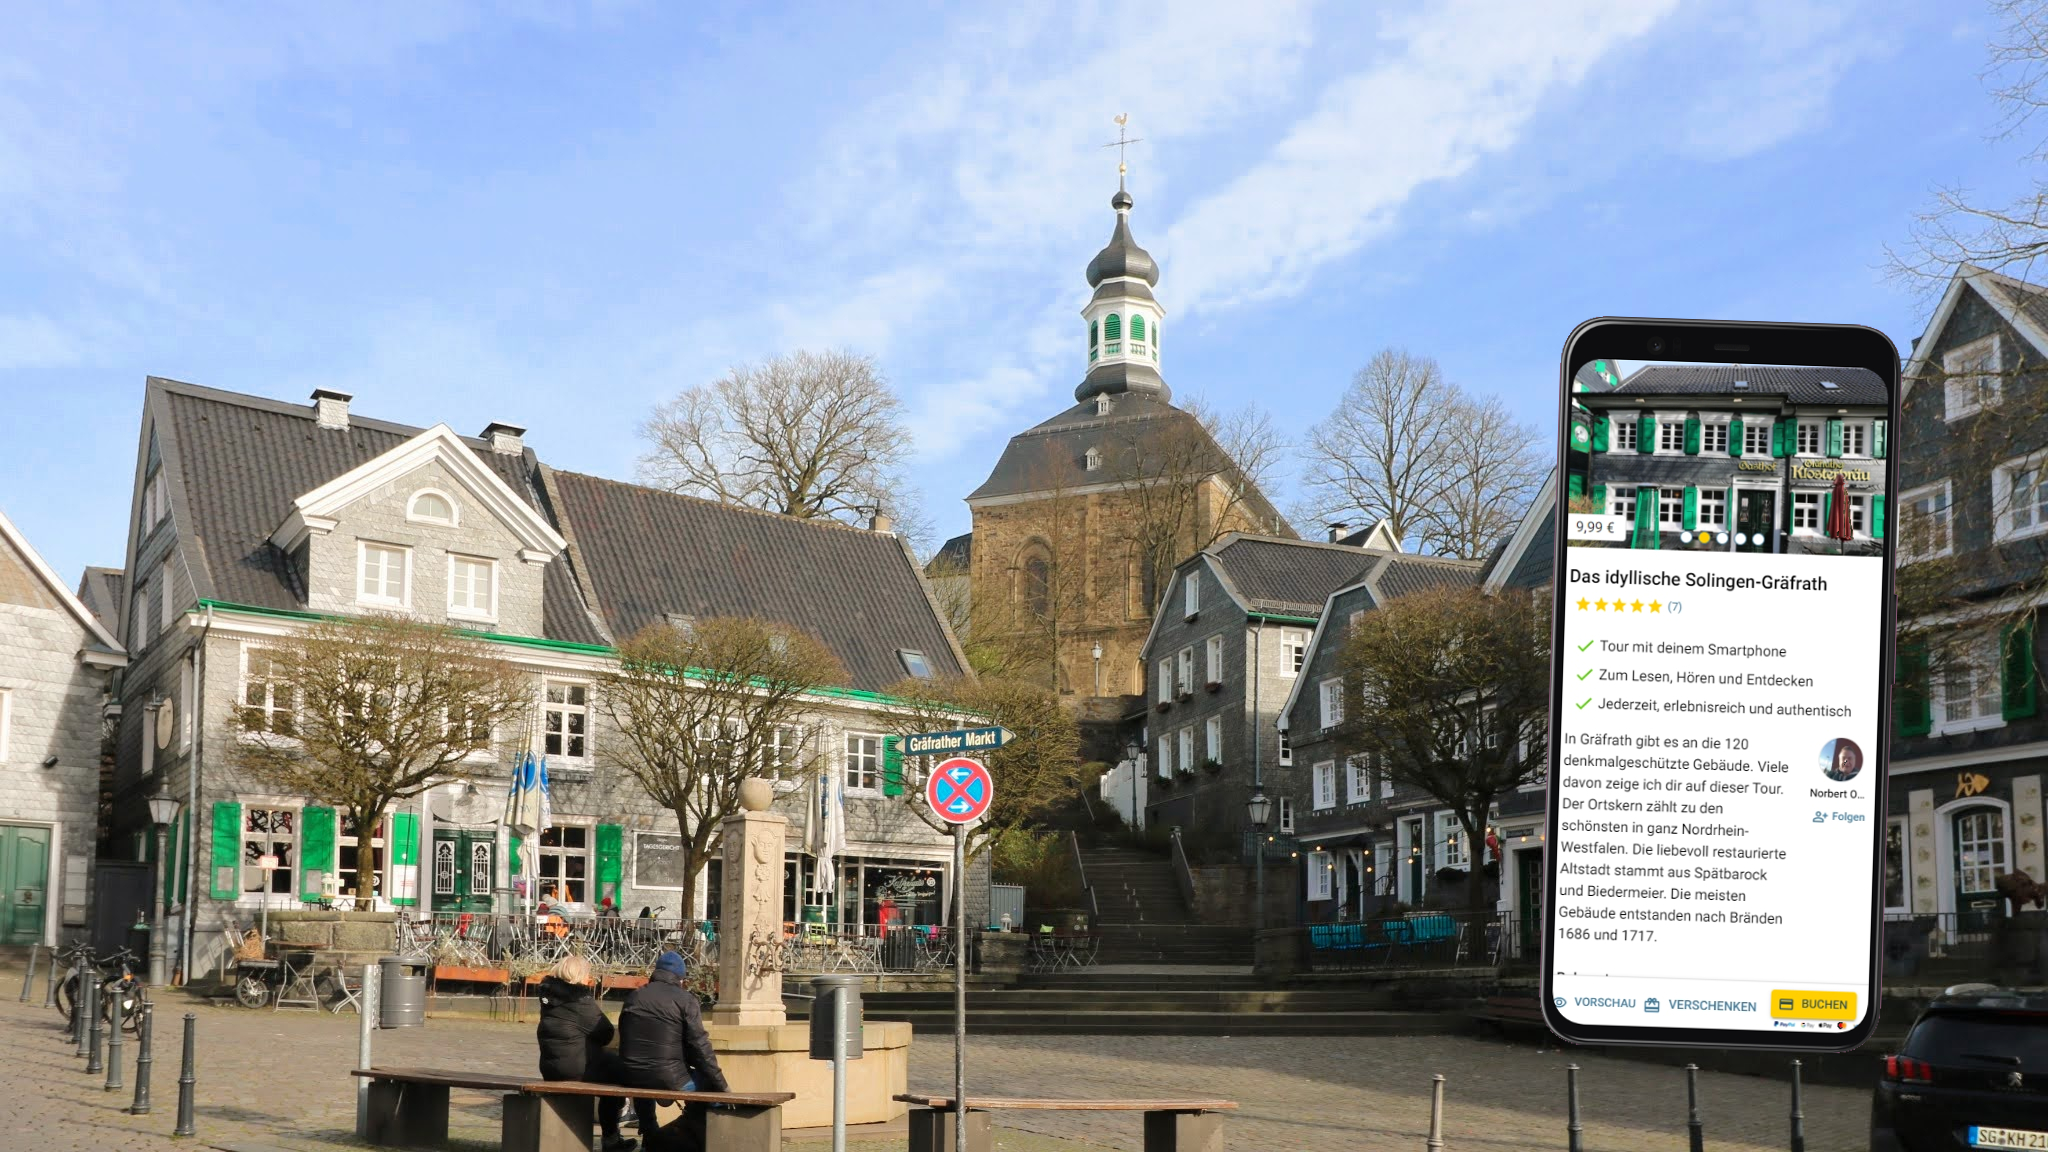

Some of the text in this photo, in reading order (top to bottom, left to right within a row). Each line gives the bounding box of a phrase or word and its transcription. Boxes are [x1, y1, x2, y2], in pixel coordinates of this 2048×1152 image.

[1577, 521, 1602, 534] 9,99
[1570, 569, 1827, 591] Das idyllische Solingen-Gräfrath
[1668, 602, 1682, 613] (7)
[1600, 640, 1786, 658] Tour mit deinem Smartphone
[1599, 669, 1813, 687] Zum Lesen, Hören und Entdecken
[1598, 698, 1851, 717] Jederzeit, erlebnisreich und authentisch
[910, 731, 995, 751] Gräfrather Markt
[1565, 733, 1748, 750] In Gräfrath gibt es an die 120
[1564, 754, 1788, 773] denkmalgeschützte Gebäude. Viele
[1563, 776, 1783, 794] davon zeige ich dir auf dieser Tour.
[1810, 788, 1847, 798] Norbert
[1563, 798, 1723, 814] Der Ortskern zählt zu den
[1832, 812, 1865, 823] Folgen
[1562, 819, 1749, 836] schönsten in ganz Nordrhein-
[1561, 841, 1786, 860] Westfalen. Die liebevoll restaurierte
[1560, 862, 1767, 881] Altstadt stammt aus Spätbarock
[1560, 885, 1745, 901] und Biedermeier. Die meisten
[1559, 906, 1782, 924] Gebäude entstanden nach Bränden
[1559, 928, 1657, 942] 1686 und 1717.
[1575, 997, 1756, 1012] VORSCHAU VERSCHENKEN
[1802, 999, 1847, 1009] BUCHEN
[1979, 1129, 2048, 1149] SG KH 21
